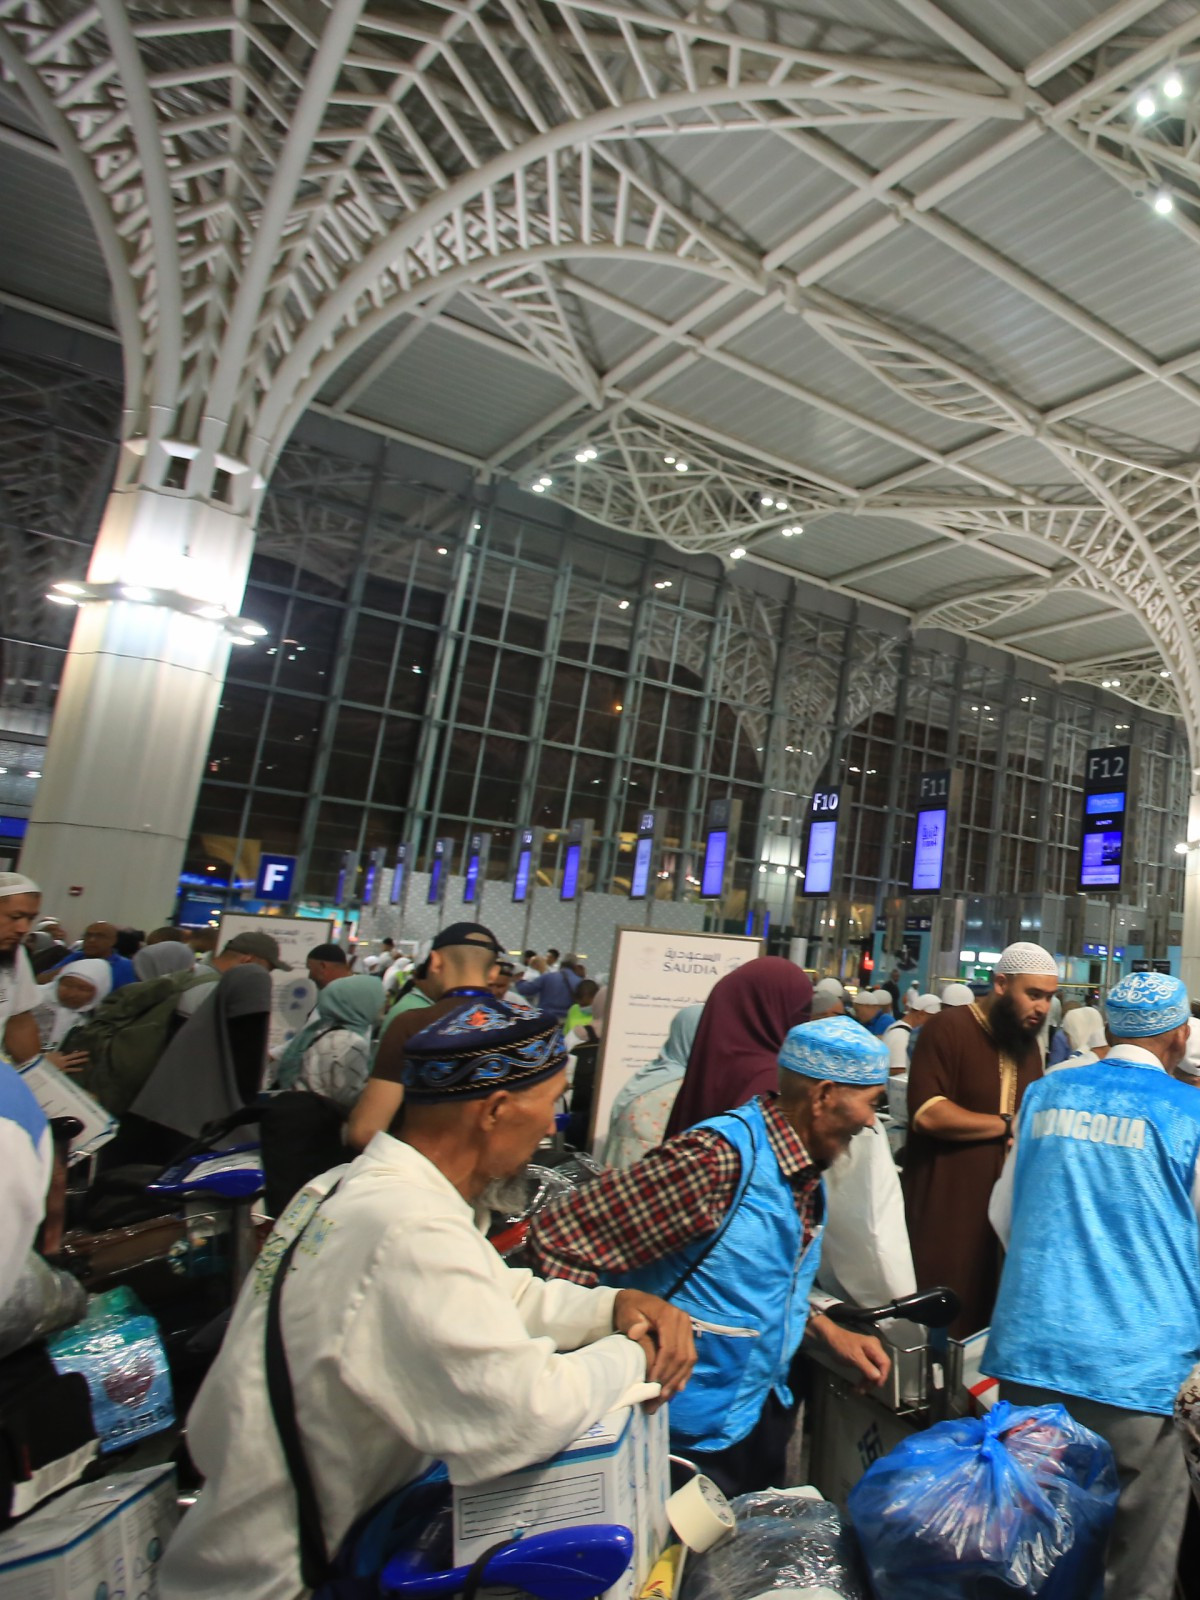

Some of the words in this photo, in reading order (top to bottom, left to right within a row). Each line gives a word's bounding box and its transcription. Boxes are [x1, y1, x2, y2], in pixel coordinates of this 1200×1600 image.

[1089, 757, 1124, 779] F12
[920, 778, 947, 797] F11
[812, 792, 839, 811] F10
[263, 864, 288, 891] F
[664, 948, 722, 962] السعودية
[662, 961, 718, 975] SAUDIA
[1031, 1108, 1145, 1149] MONGOLIA
